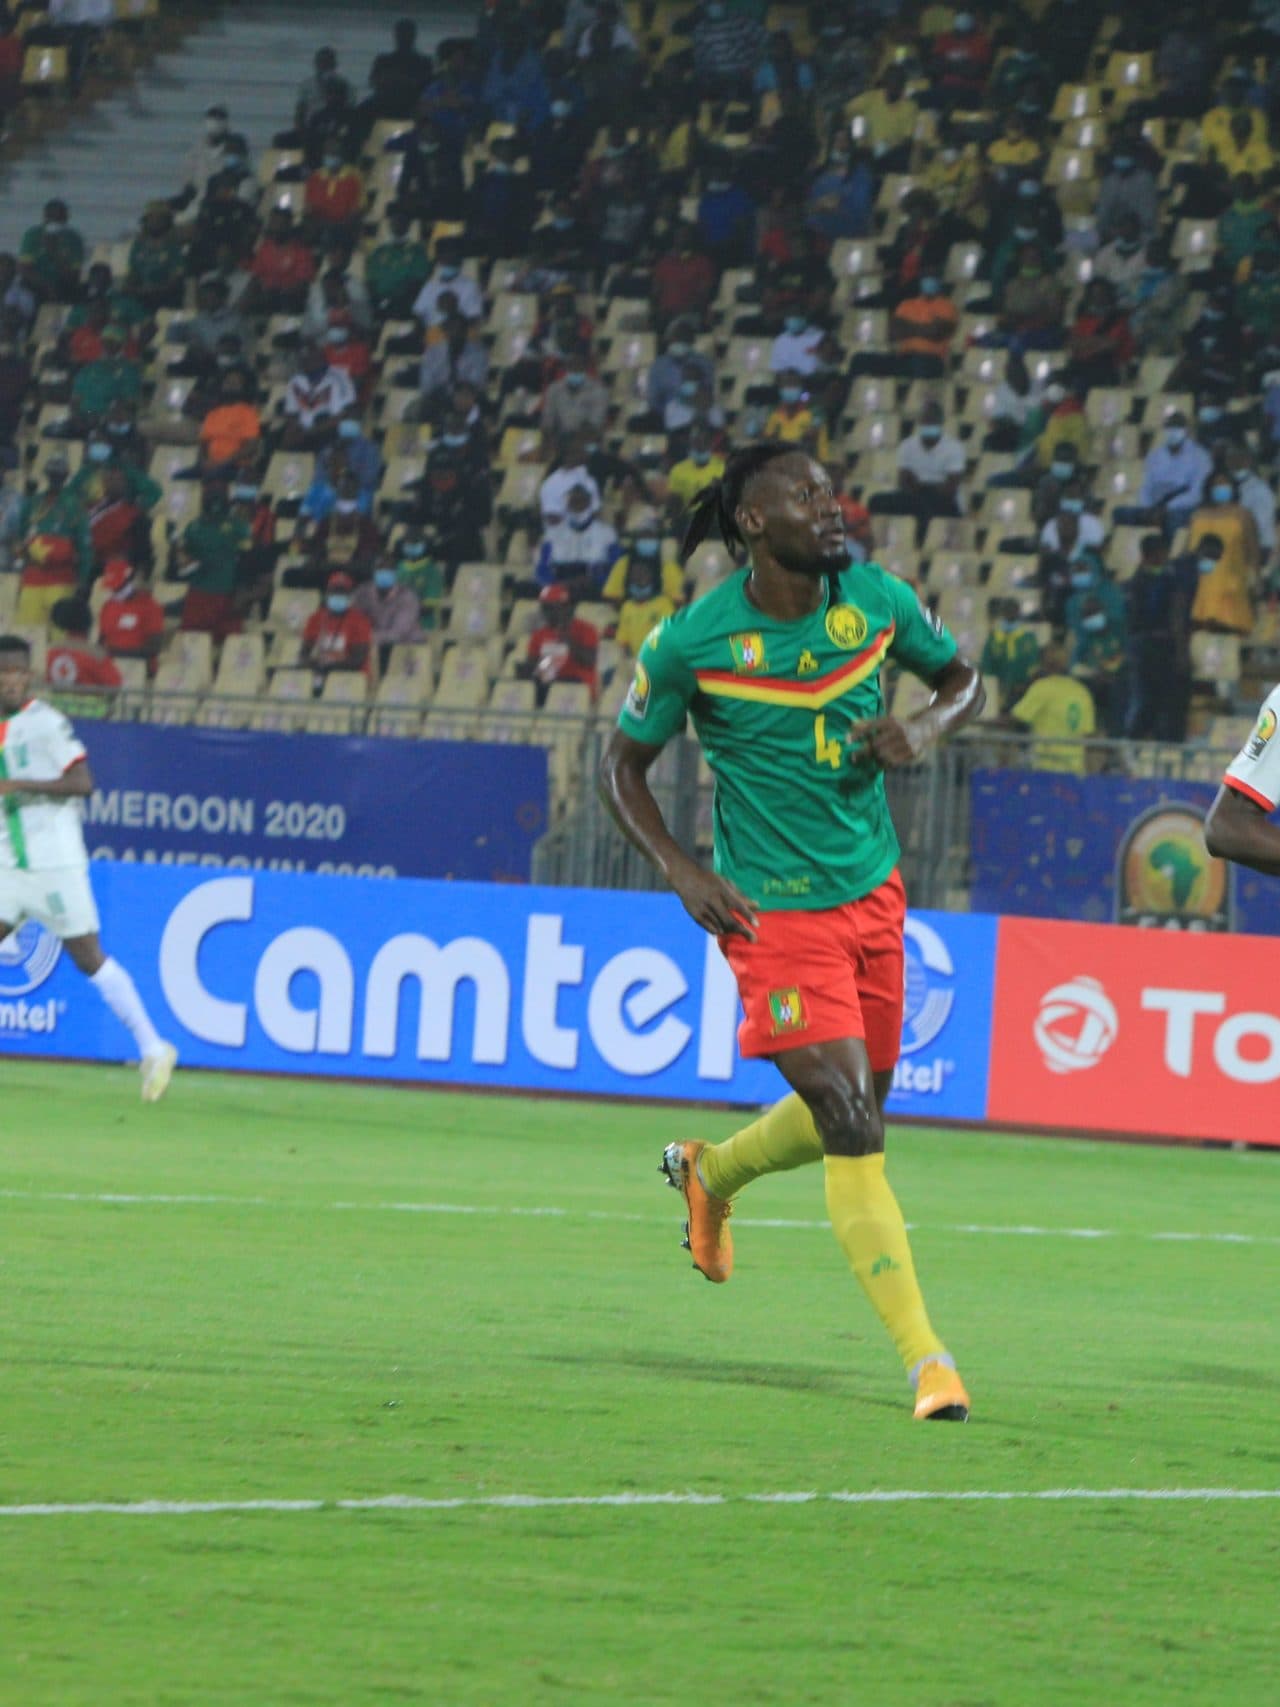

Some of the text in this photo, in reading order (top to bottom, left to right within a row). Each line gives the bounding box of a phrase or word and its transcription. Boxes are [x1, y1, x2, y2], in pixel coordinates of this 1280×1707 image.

[814, 714, 841, 769] 4
[80, 789, 346, 840] MEROON 2020
[159, 876, 739, 1080] Camtel
